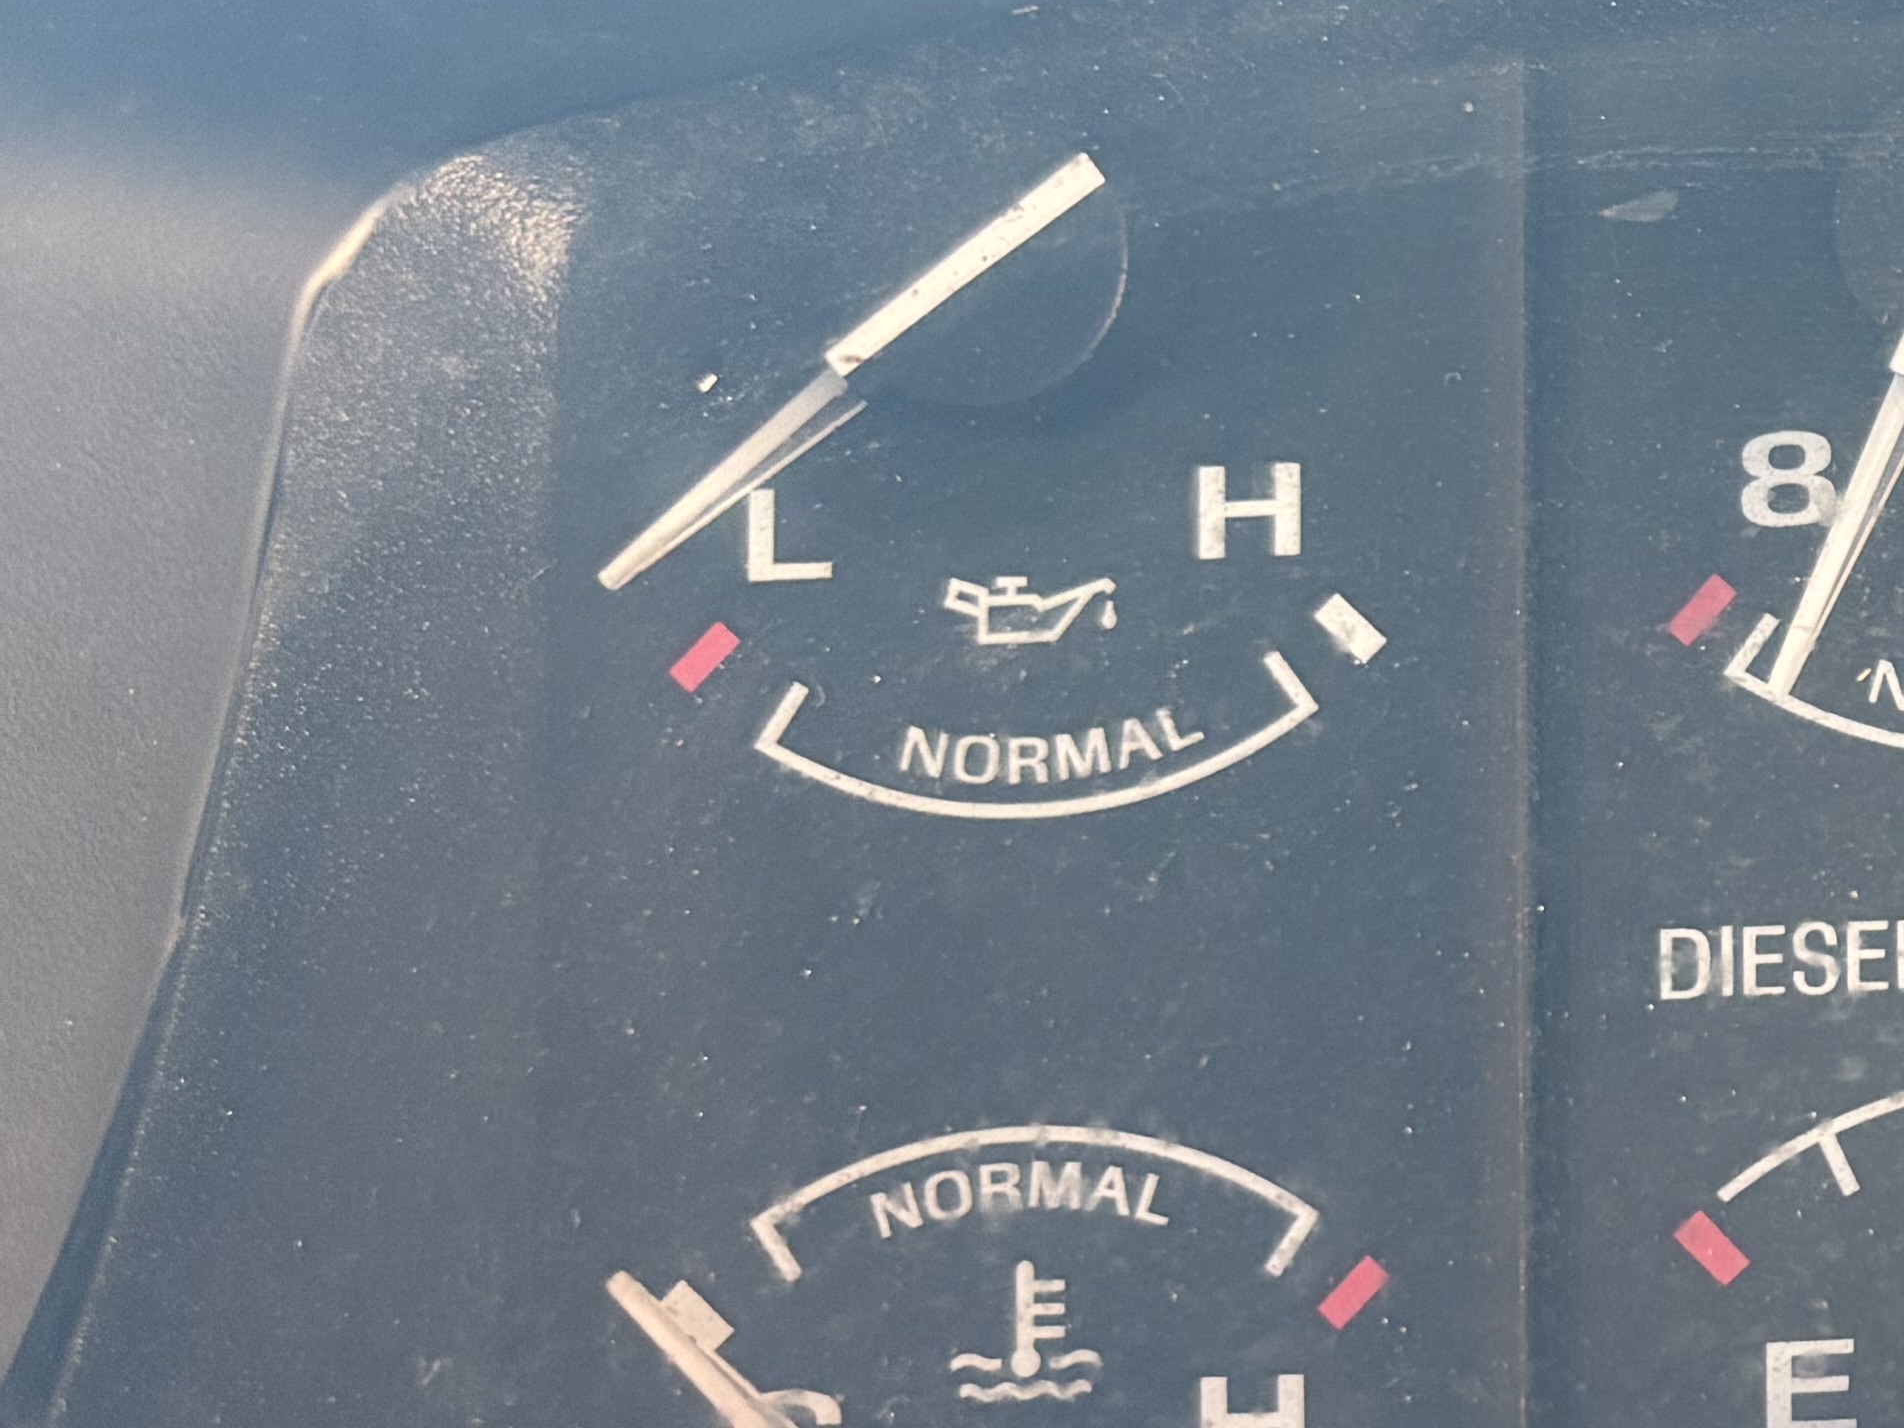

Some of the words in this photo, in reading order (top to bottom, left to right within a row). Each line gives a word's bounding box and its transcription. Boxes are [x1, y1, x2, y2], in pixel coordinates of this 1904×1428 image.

[1198, 462, 1301, 560] H
[1740, 430, 1838, 527] 8
[748, 488, 832, 581] L
[898, 708, 1204, 785] NORMAL
[869, 1160, 1169, 1239] NORMAL
